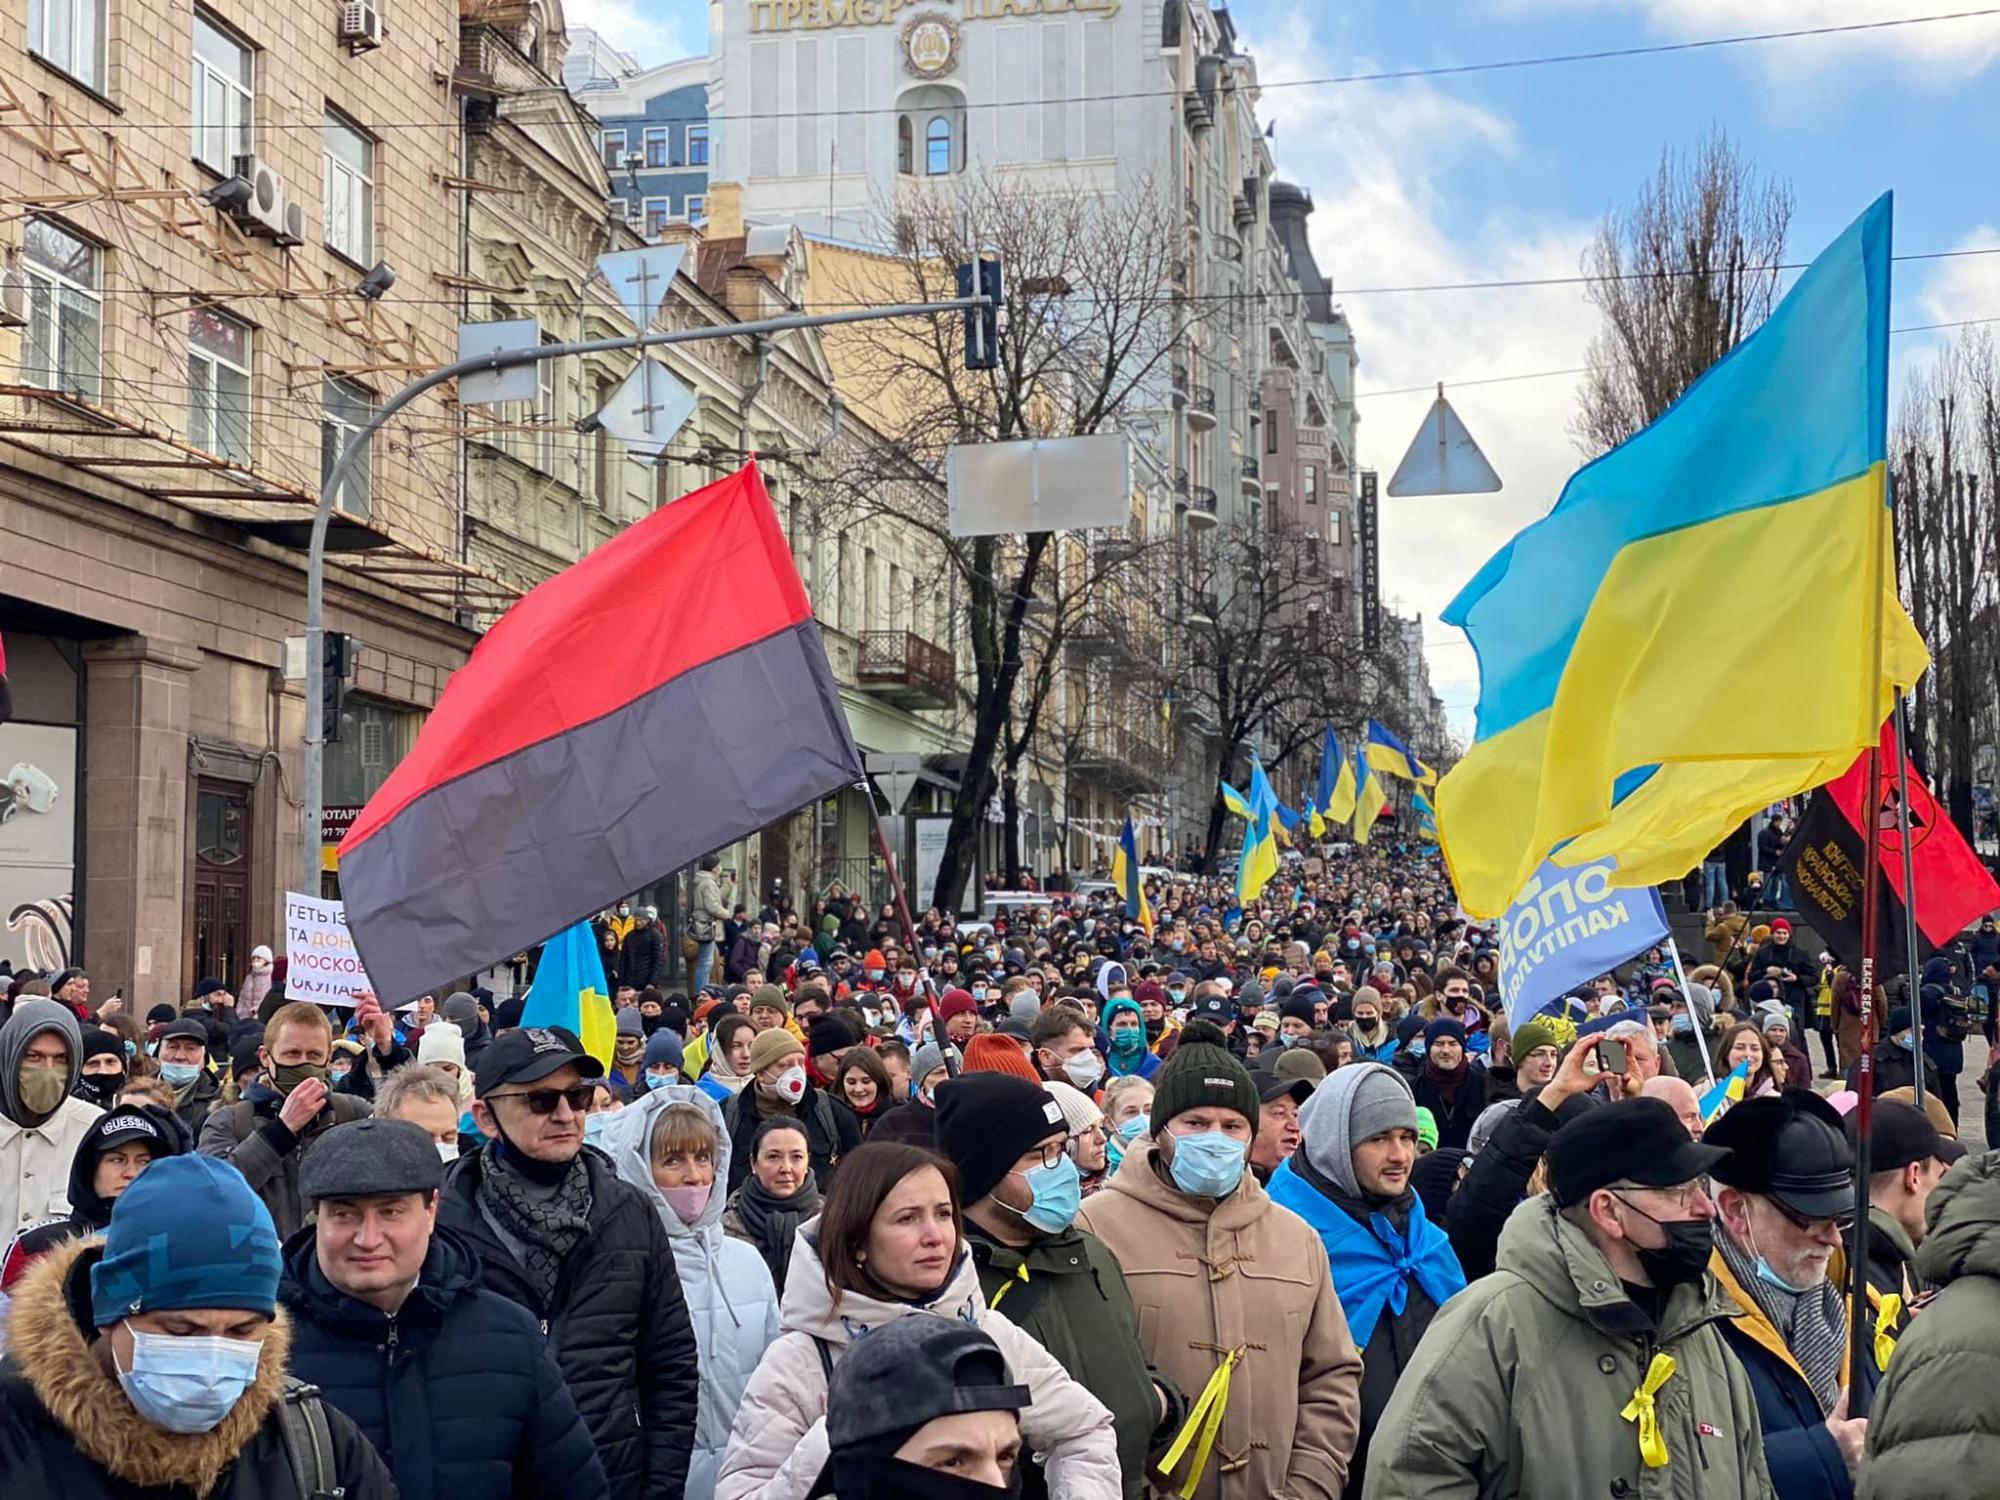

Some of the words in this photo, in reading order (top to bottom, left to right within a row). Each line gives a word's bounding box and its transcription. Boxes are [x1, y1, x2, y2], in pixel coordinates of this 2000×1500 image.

[1366, 540, 1375, 586] ПАЛАЦ
[289, 903, 328, 923] ГЕТЬ
[289, 926, 308, 944] ТА
[1862, 957, 1873, 990] BLACK
[1861, 993, 1872, 1014] SEA
